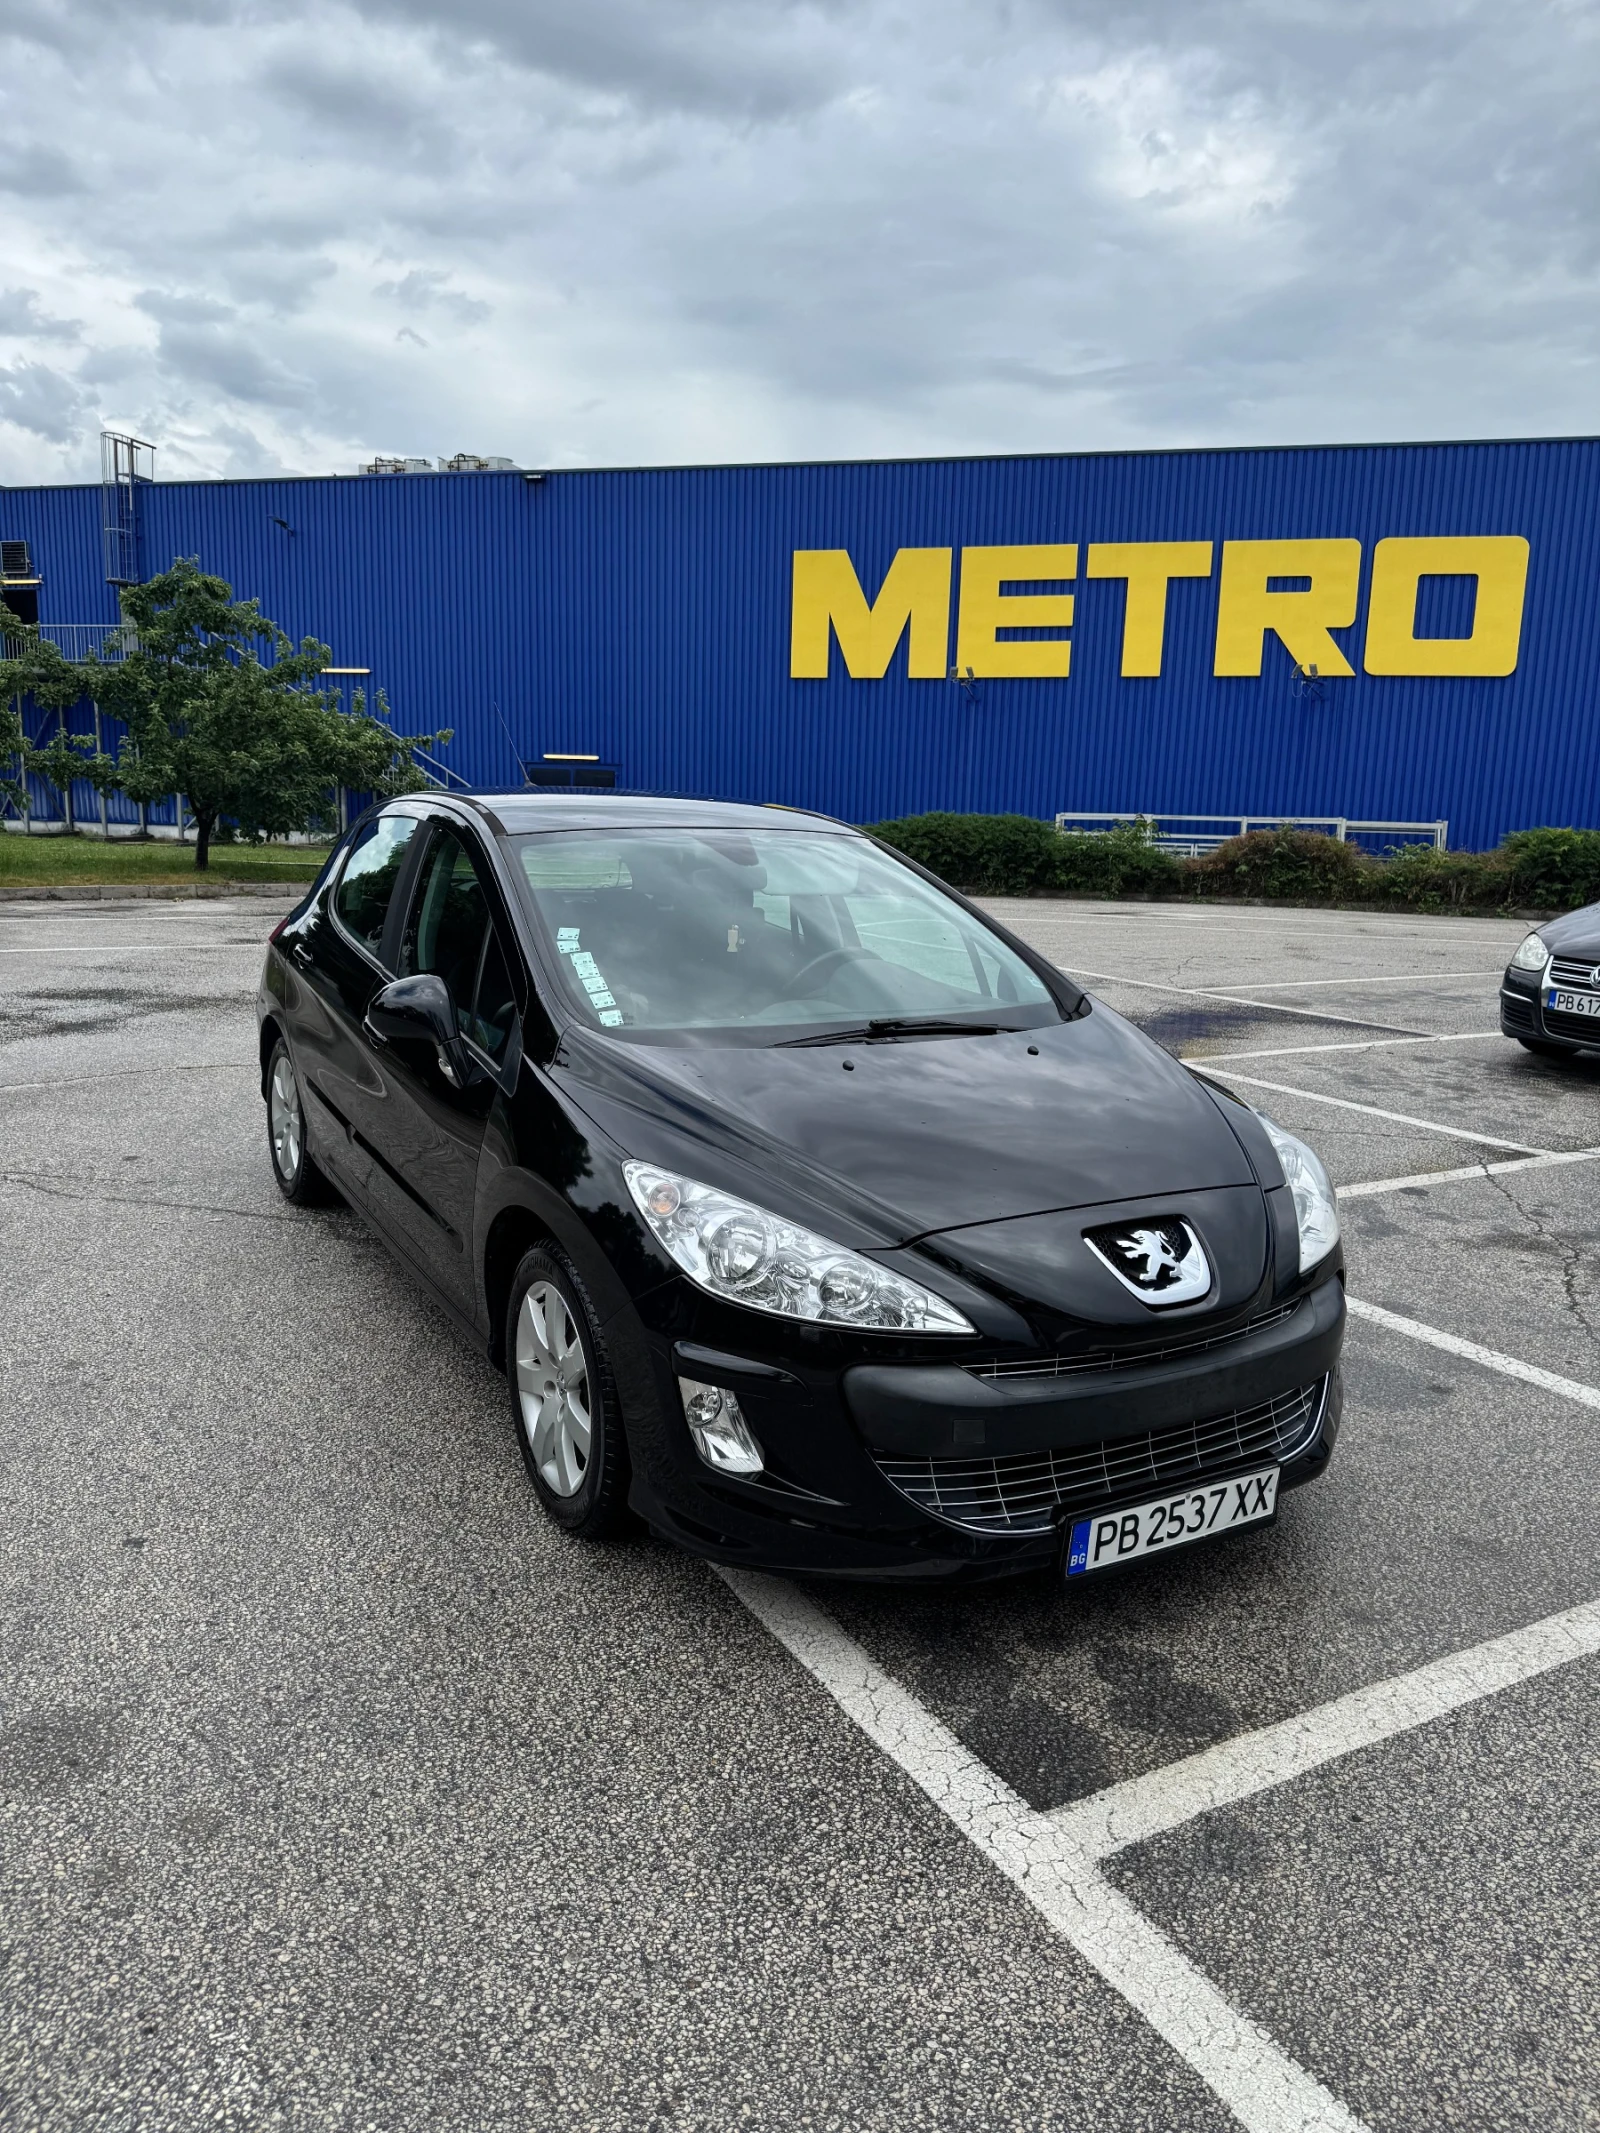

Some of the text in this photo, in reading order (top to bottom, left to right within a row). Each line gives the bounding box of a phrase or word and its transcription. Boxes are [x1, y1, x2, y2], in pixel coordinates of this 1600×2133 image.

[791, 536, 1530, 679] METRO
[1557, 994, 1574, 1010] PB
[1093, 1474, 1273, 1562] PB 2537 XX
[1070, 1553, 1086, 1567] BG
